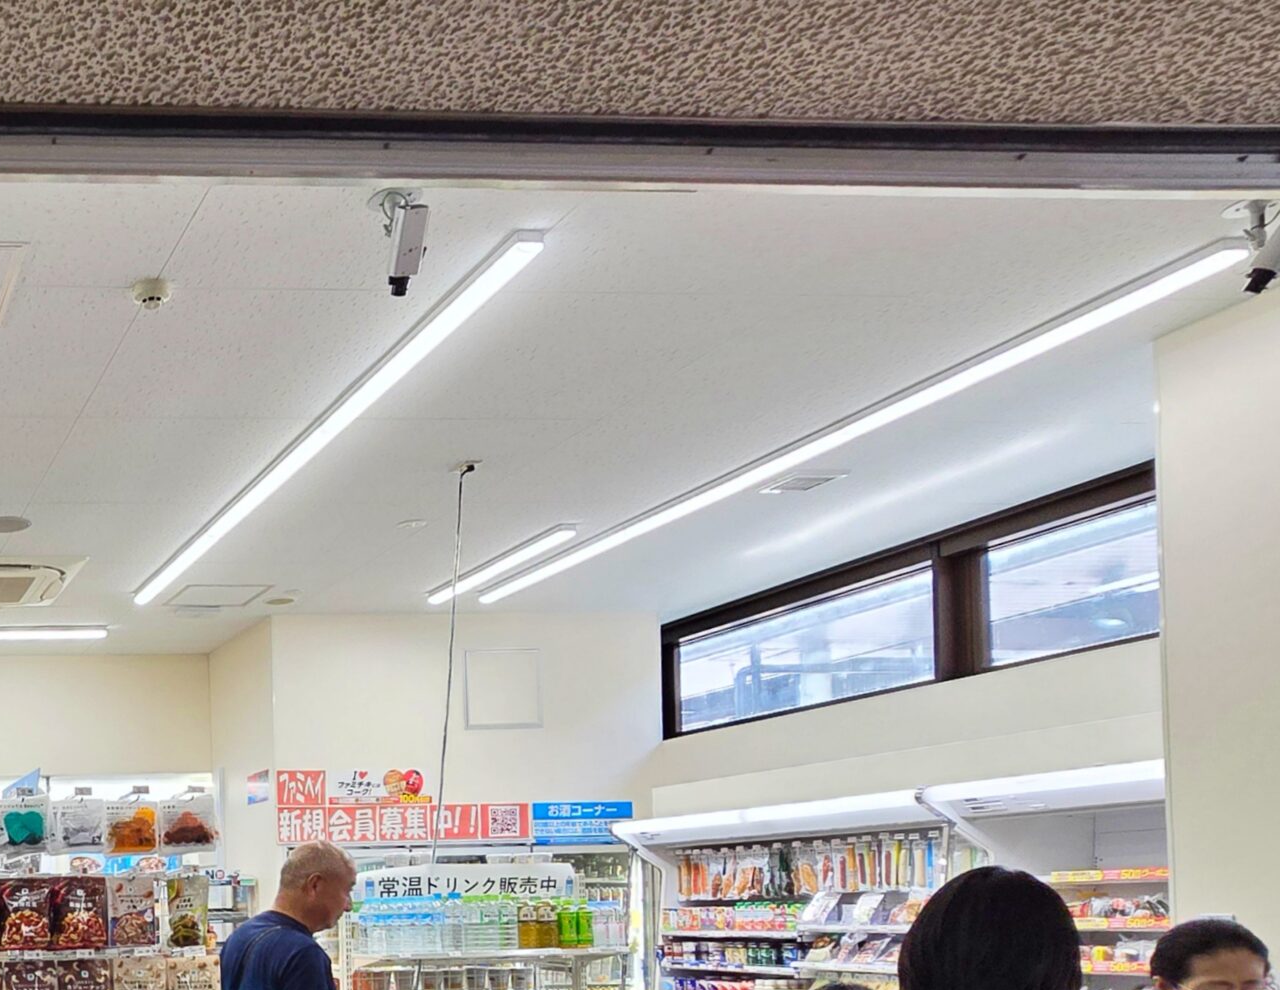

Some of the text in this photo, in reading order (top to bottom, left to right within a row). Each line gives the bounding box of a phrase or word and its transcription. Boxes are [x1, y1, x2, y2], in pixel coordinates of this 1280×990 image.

[547, 804, 618, 817] お酒コーナー
[278, 805, 477, 843] 新規会員募集中!!
[378, 875, 558, 898] 常温ドリンク販売中
